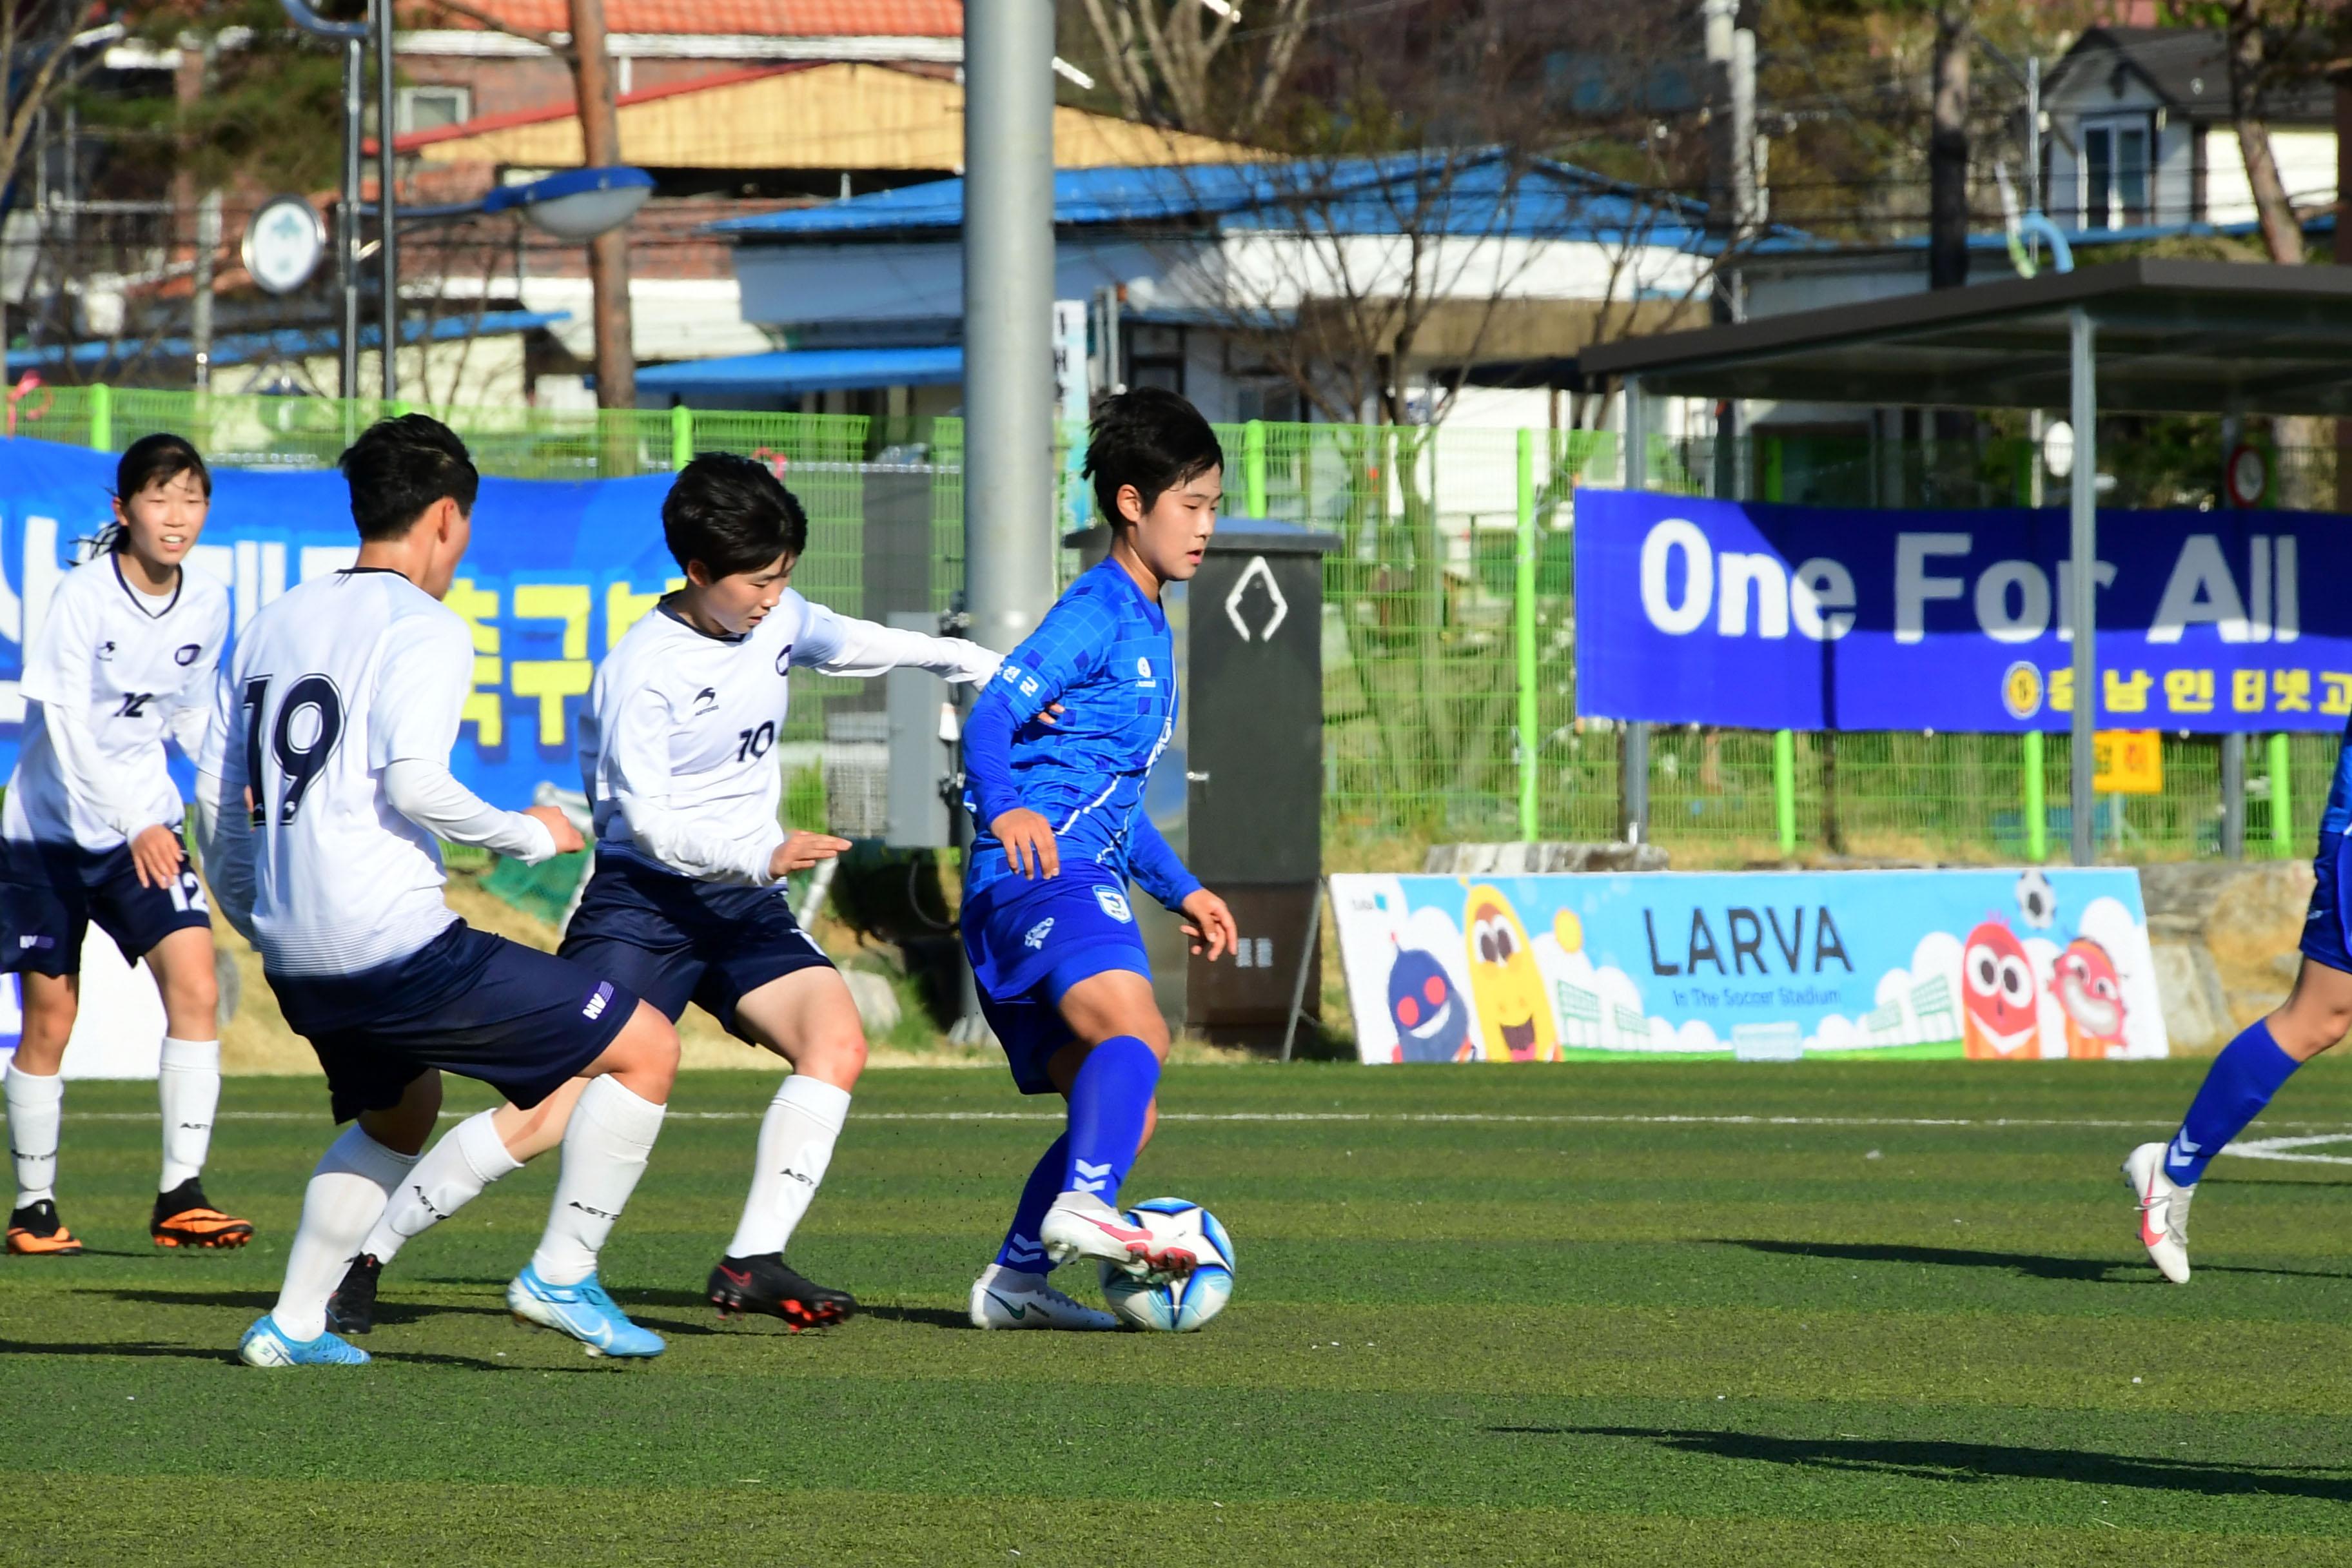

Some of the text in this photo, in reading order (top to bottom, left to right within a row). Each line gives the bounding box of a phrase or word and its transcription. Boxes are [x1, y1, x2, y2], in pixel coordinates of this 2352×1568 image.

[1640, 518, 2300, 643] One For All
[243, 672, 347, 826] 19
[737, 720, 775, 762] 10
[169, 872, 210, 913] 12
[1643, 905, 1856, 975] LARVA
[1691, 988, 1720, 1007] The
[1723, 987, 1774, 1007] Soccer
[1778, 985, 1841, 1006] Stadium
